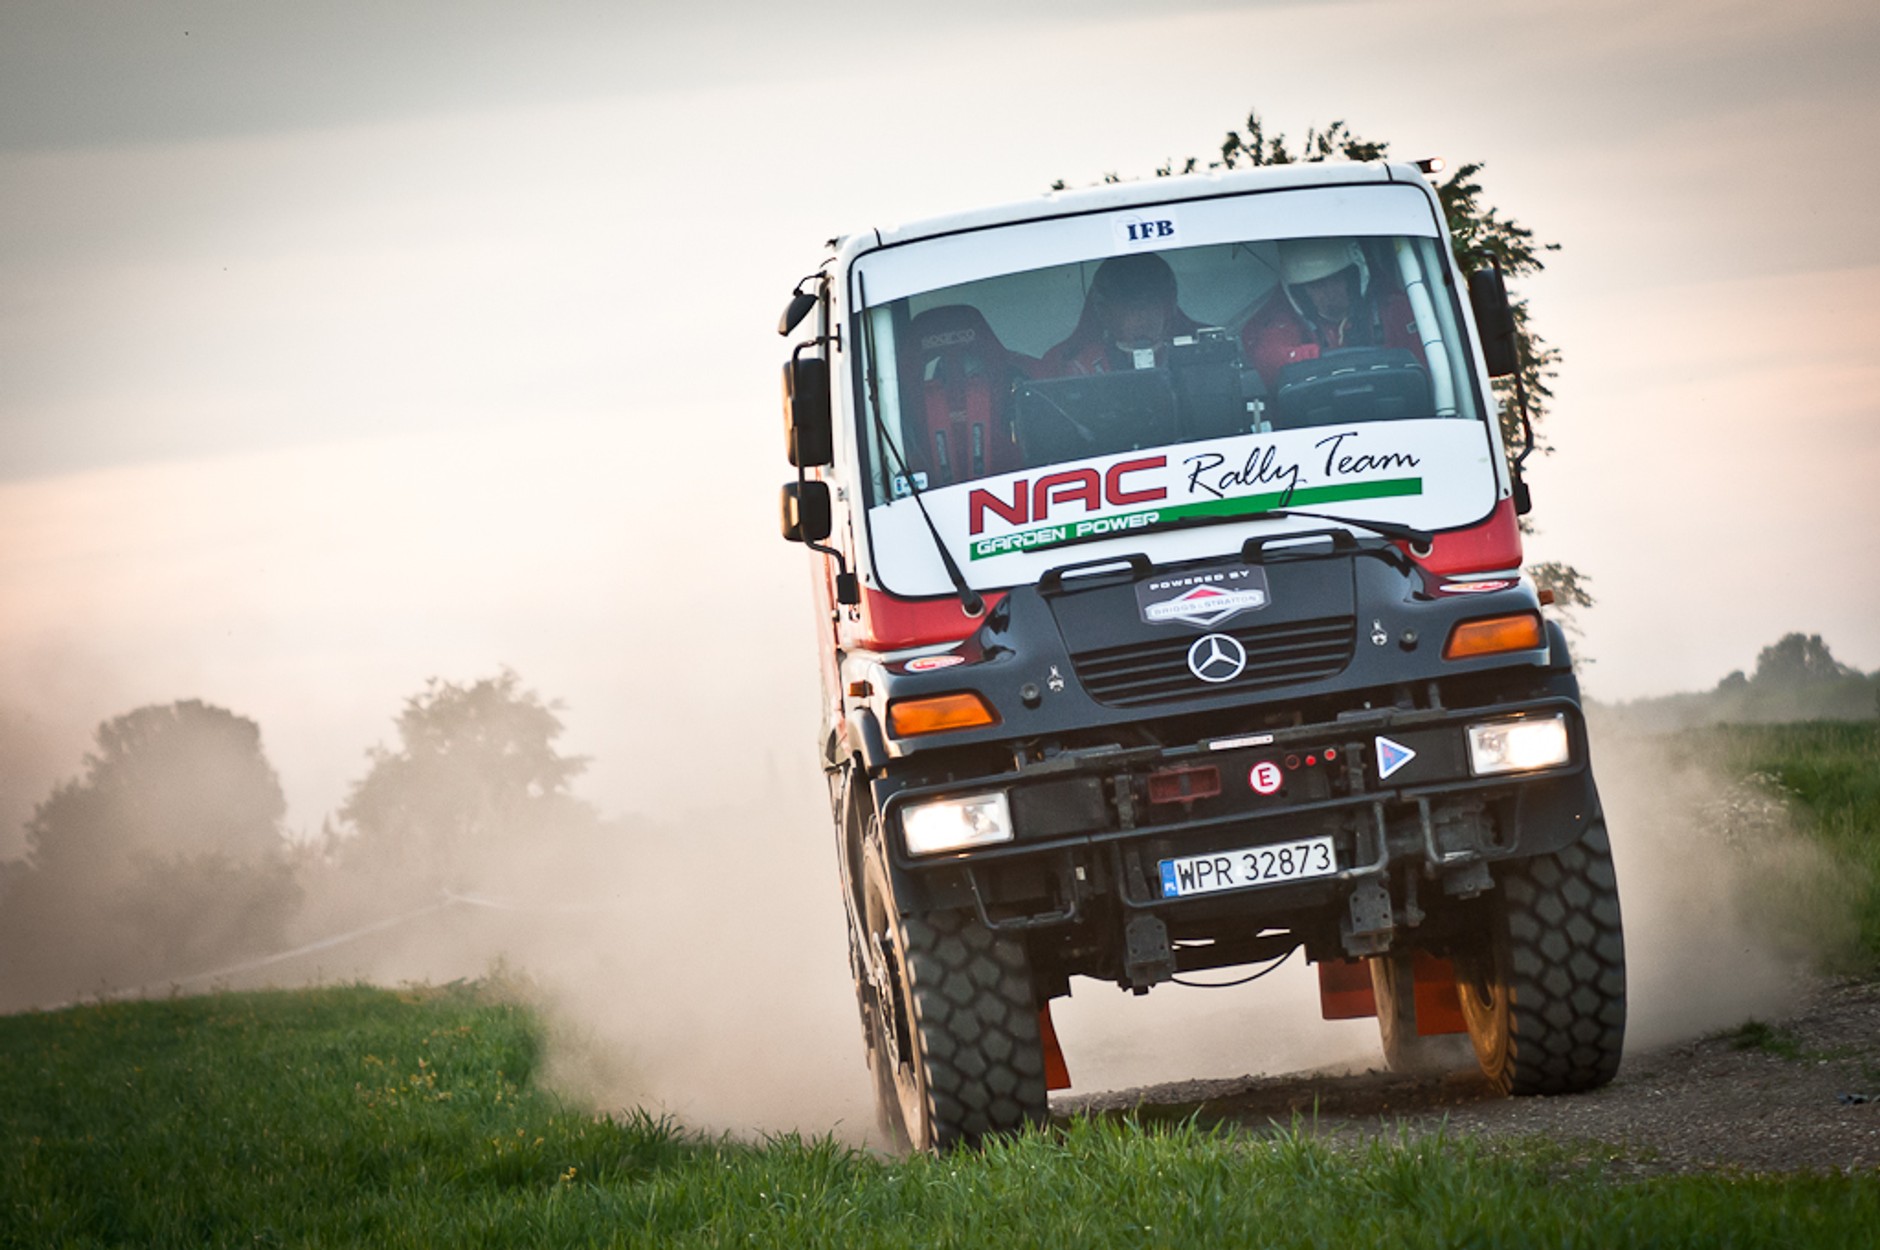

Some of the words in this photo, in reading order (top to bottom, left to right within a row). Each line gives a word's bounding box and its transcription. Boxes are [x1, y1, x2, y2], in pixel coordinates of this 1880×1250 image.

[1126, 219, 1175, 241] IFB
[1183, 444, 1307, 507] Rally
[1314, 431, 1421, 477] Team
[969, 455, 1167, 536] NAC
[976, 526, 1067, 555] GARDEN
[1076, 511, 1160, 538] POWER
[1149, 573, 1225, 591] POWERED
[1228, 570, 1250, 580] BY
[1258, 767, 1274, 787] E
[1177, 857, 1234, 891] WPR
[1242, 843, 1332, 881] 32873
